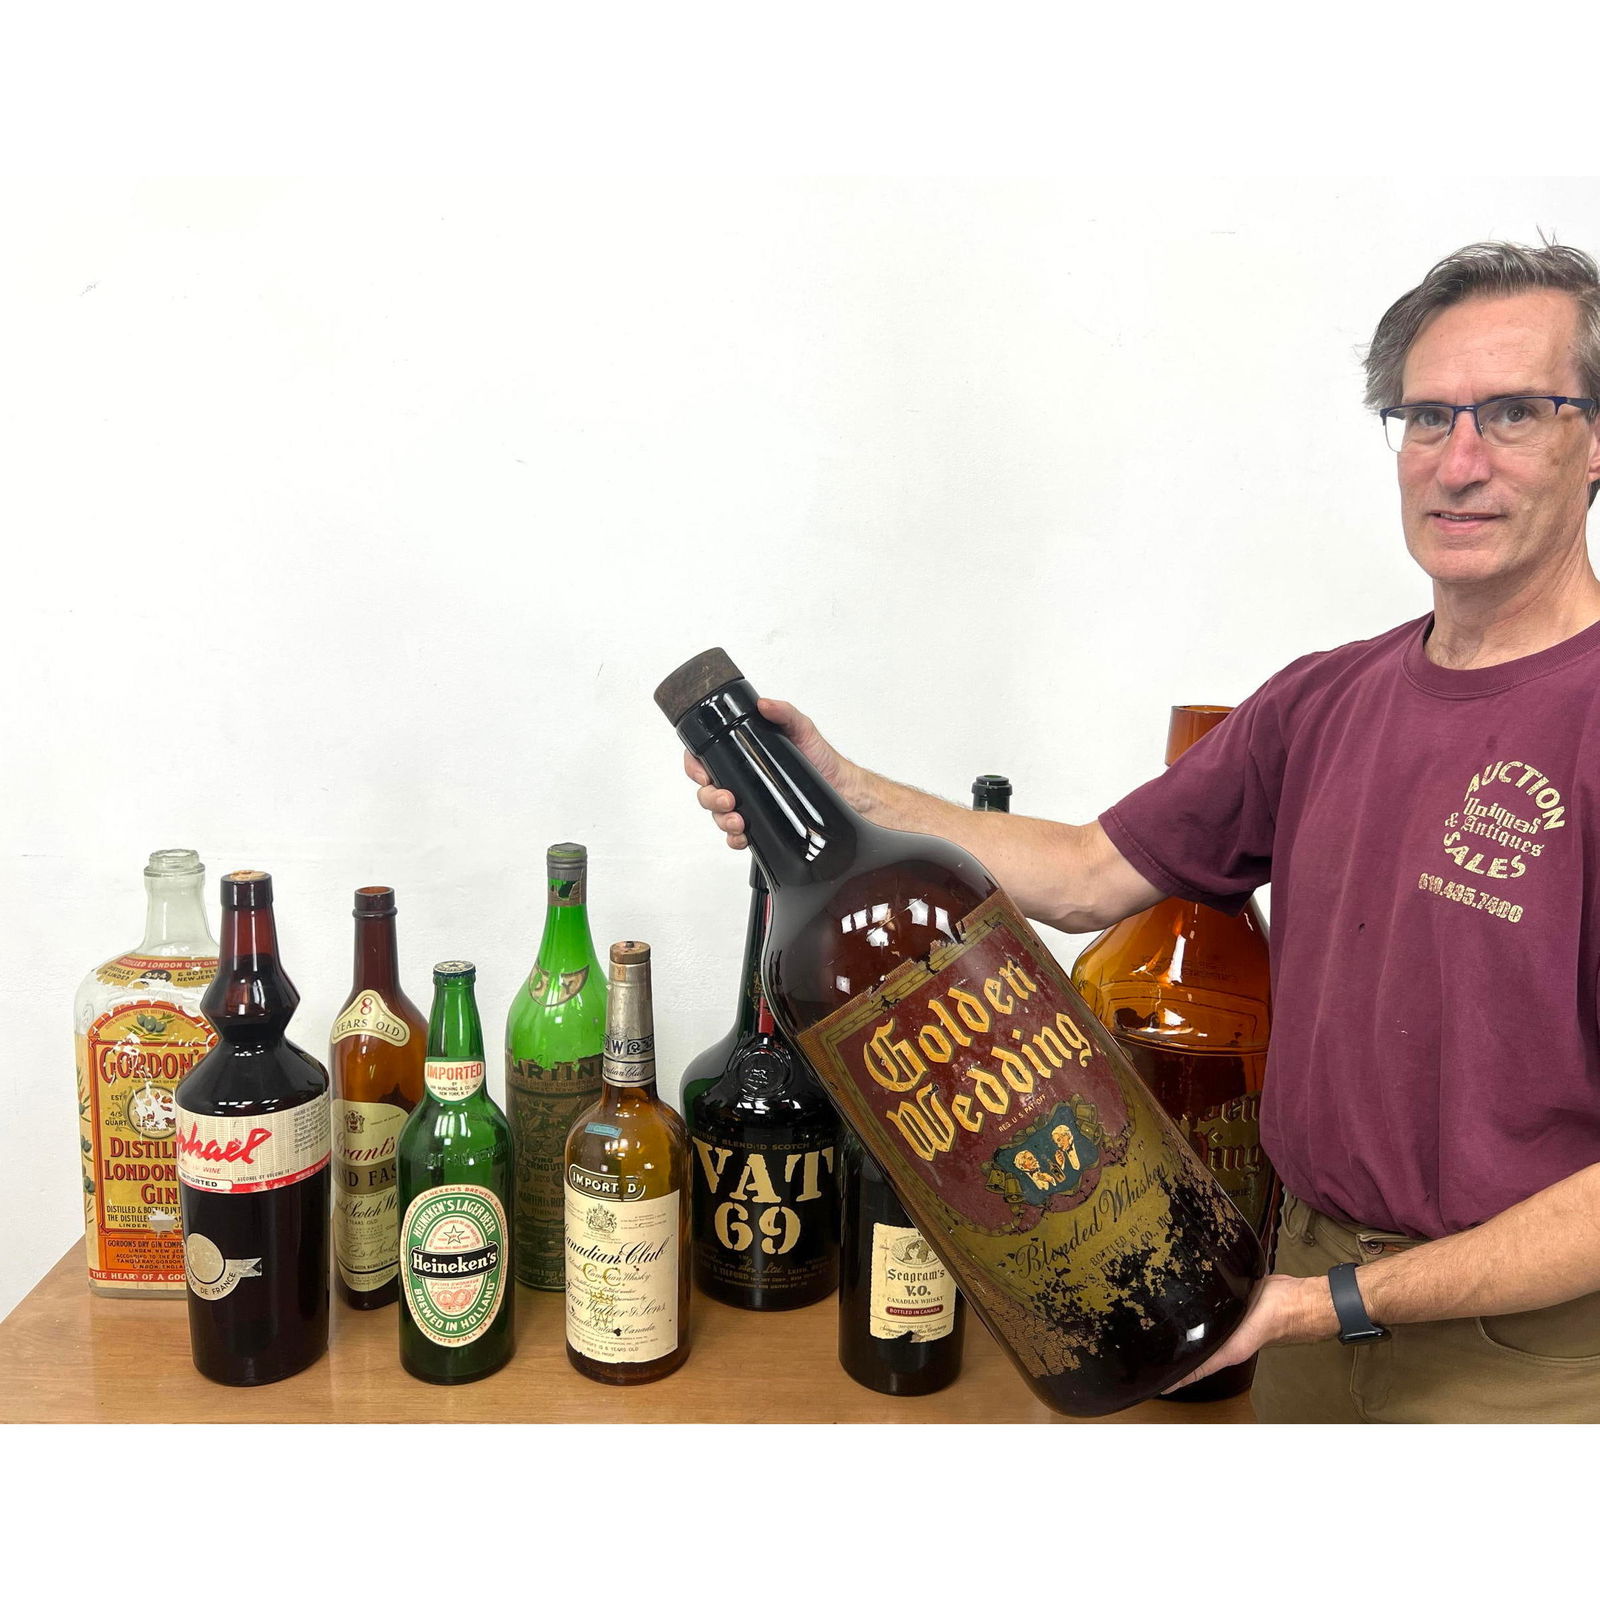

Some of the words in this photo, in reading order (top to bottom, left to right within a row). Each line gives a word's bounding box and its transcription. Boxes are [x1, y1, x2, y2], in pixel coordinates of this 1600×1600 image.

[1464, 760, 1566, 830] AUCTION
[1463, 797, 1541, 835] Uniques
[1444, 812, 1458, 828] &
[1461, 815, 1545, 857] Antiques
[1443, 831, 1526, 879] SALES
[360, 997, 373, 1016] 8
[336, 1018, 368, 1034] YEARS
[375, 1020, 400, 1037] OLD
[863, 959, 1038, 1093] Golden
[612, 1039, 624, 1054] W
[427, 1063, 482, 1081] IMPORTED
[625, 1065, 645, 1078] Club
[886, 1011, 1093, 1162] Wedding
[771, 1142, 810, 1151] SCOTCH
[104, 1159, 178, 1182] LONDON
[692, 1136, 834, 1204] VAT
[140, 1183, 179, 1205] GIN
[106, 1205, 136, 1214] DISTILLED
[107, 1213, 119, 1222] THE
[350, 1199, 382, 1219] Scotch
[412, 1199, 456, 1239] HEINEKEN'S
[456, 1199, 485, 1218] LAGER
[480, 1212, 497, 1236] BEER
[714, 1201, 801, 1255] 69
[619, 1237, 670, 1265] Club
[1014, 1206, 1103, 1280] Blended
[1090, 1234, 1128, 1267] BOTTLED
[1128, 1224, 1141, 1237] BY
[412, 1252, 498, 1274] Heineken's
[92, 1270, 108, 1279] THE
[141, 1273, 155, 1281] OF
[157, 1273, 165, 1281] A
[200, 1287, 209, 1295] DE
[211, 1271, 237, 1295] FRANCE
[621, 1271, 651, 1282] Whisky
[887, 1268, 945, 1283] Seagram's
[886, 1296, 919, 1305] CANADIAN
[920, 1295, 944, 1304] WHISKY
[905, 1285, 932, 1296] V.O.
[414, 1288, 445, 1329] BREWED
[445, 1321, 458, 1331] IN
[460, 1282, 496, 1330] HOLLAND
[585, 1298, 628, 1318] Walker
[920, 1306, 940, 1315] CANADA
